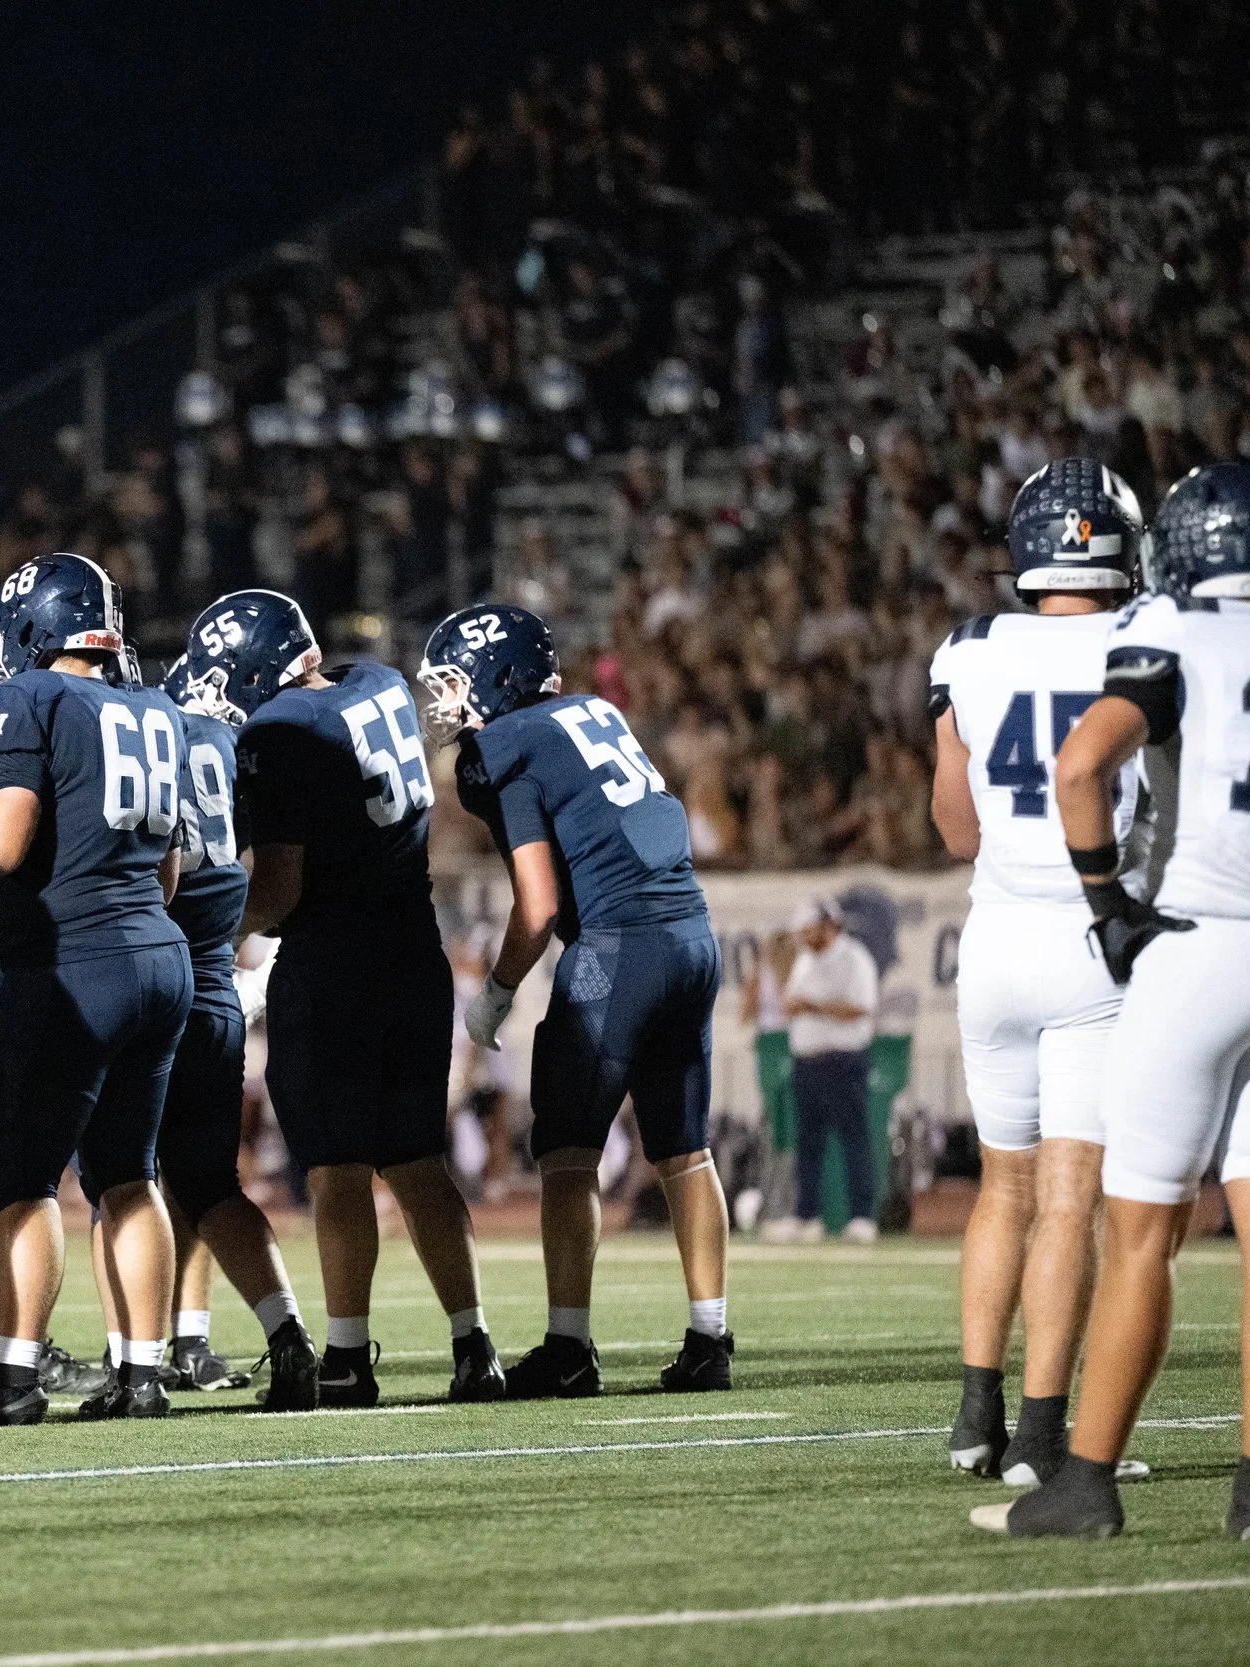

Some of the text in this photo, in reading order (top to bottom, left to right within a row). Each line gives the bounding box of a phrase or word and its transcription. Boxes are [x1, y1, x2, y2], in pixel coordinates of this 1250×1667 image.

[1, 566, 39, 603] 68
[199, 610, 243, 657] 55
[459, 614, 508, 650] 52
[99, 702, 178, 837] 68
[340, 684, 435, 828] 55
[550, 698, 666, 807] 52
